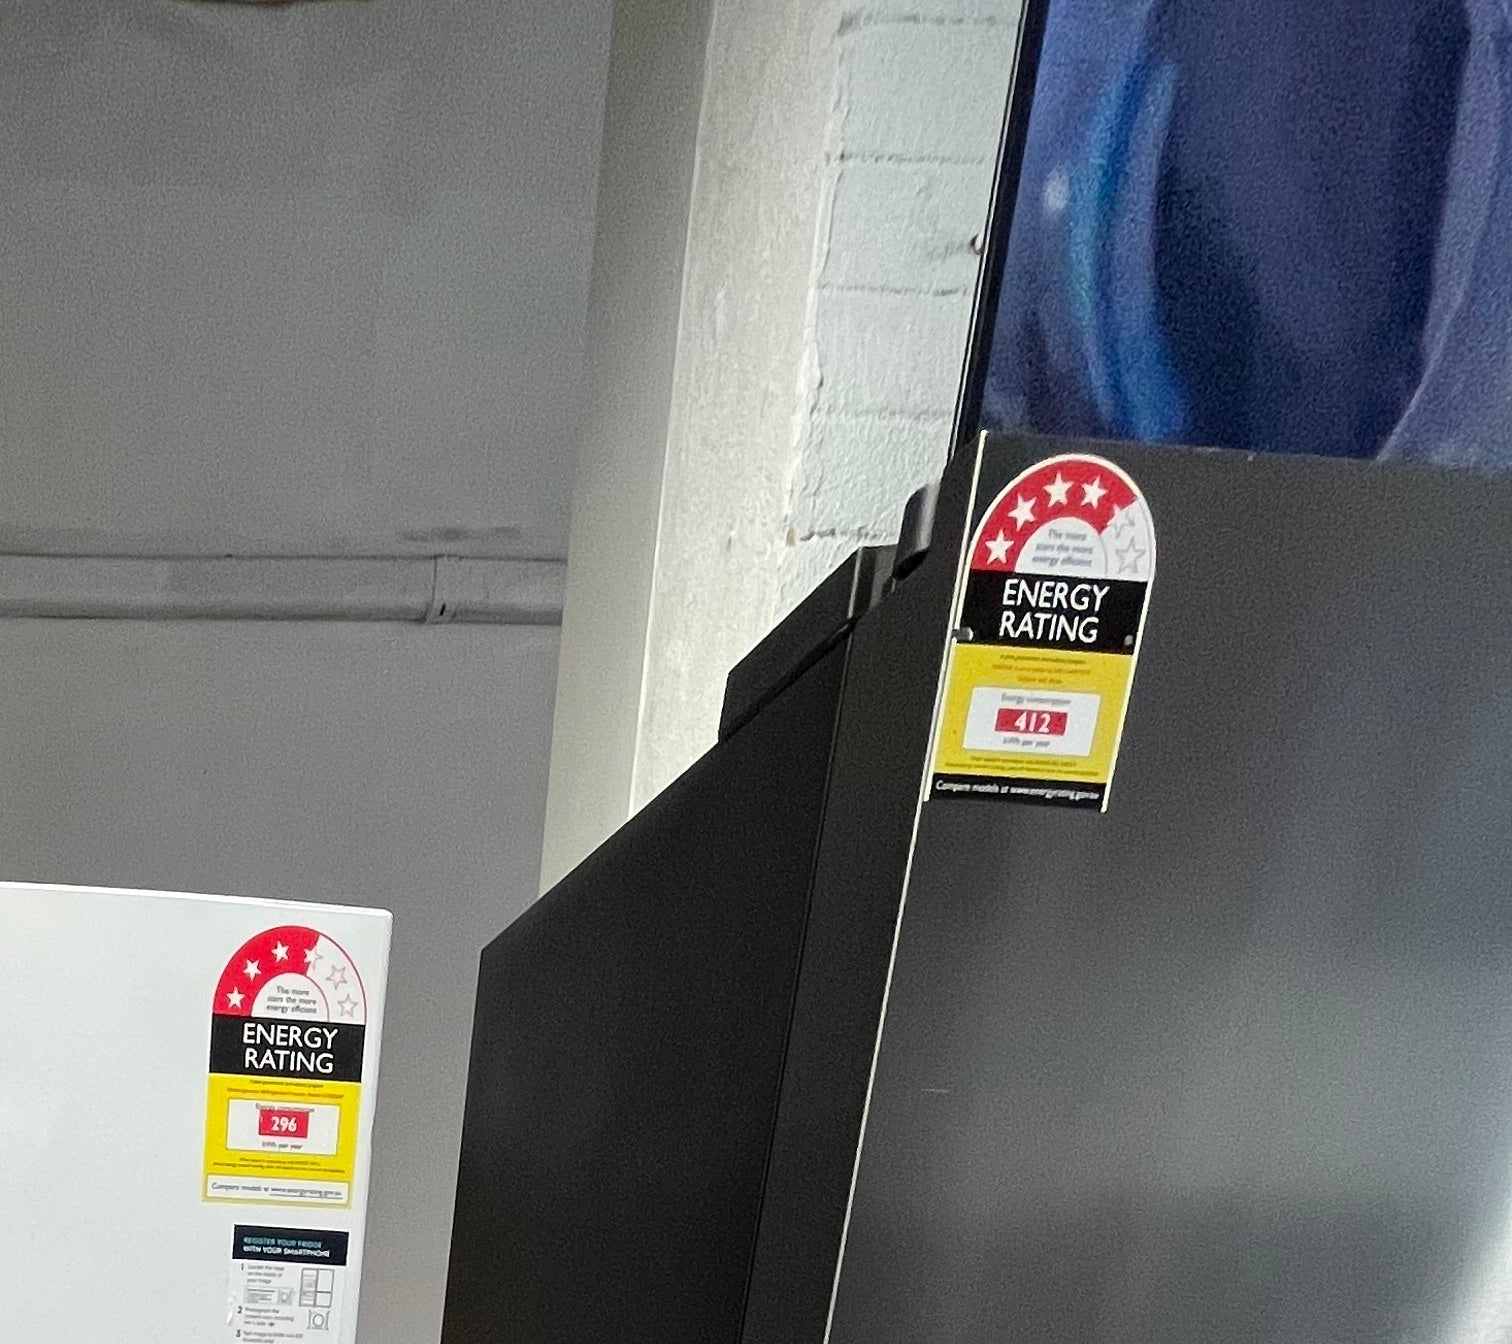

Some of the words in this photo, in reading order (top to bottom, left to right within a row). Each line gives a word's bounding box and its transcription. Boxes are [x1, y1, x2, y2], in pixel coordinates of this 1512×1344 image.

[1002, 579, 1110, 612] ENERGY
[999, 610, 1099, 643] RATING
[1015, 711, 1051, 733] 412
[935, 780, 971, 793] Compare
[242, 1022, 339, 1050] ENERGY
[244, 1047, 334, 1074] RATING
[271, 1116, 297, 1132] 296
[211, 1182, 240, 1193] Compare
